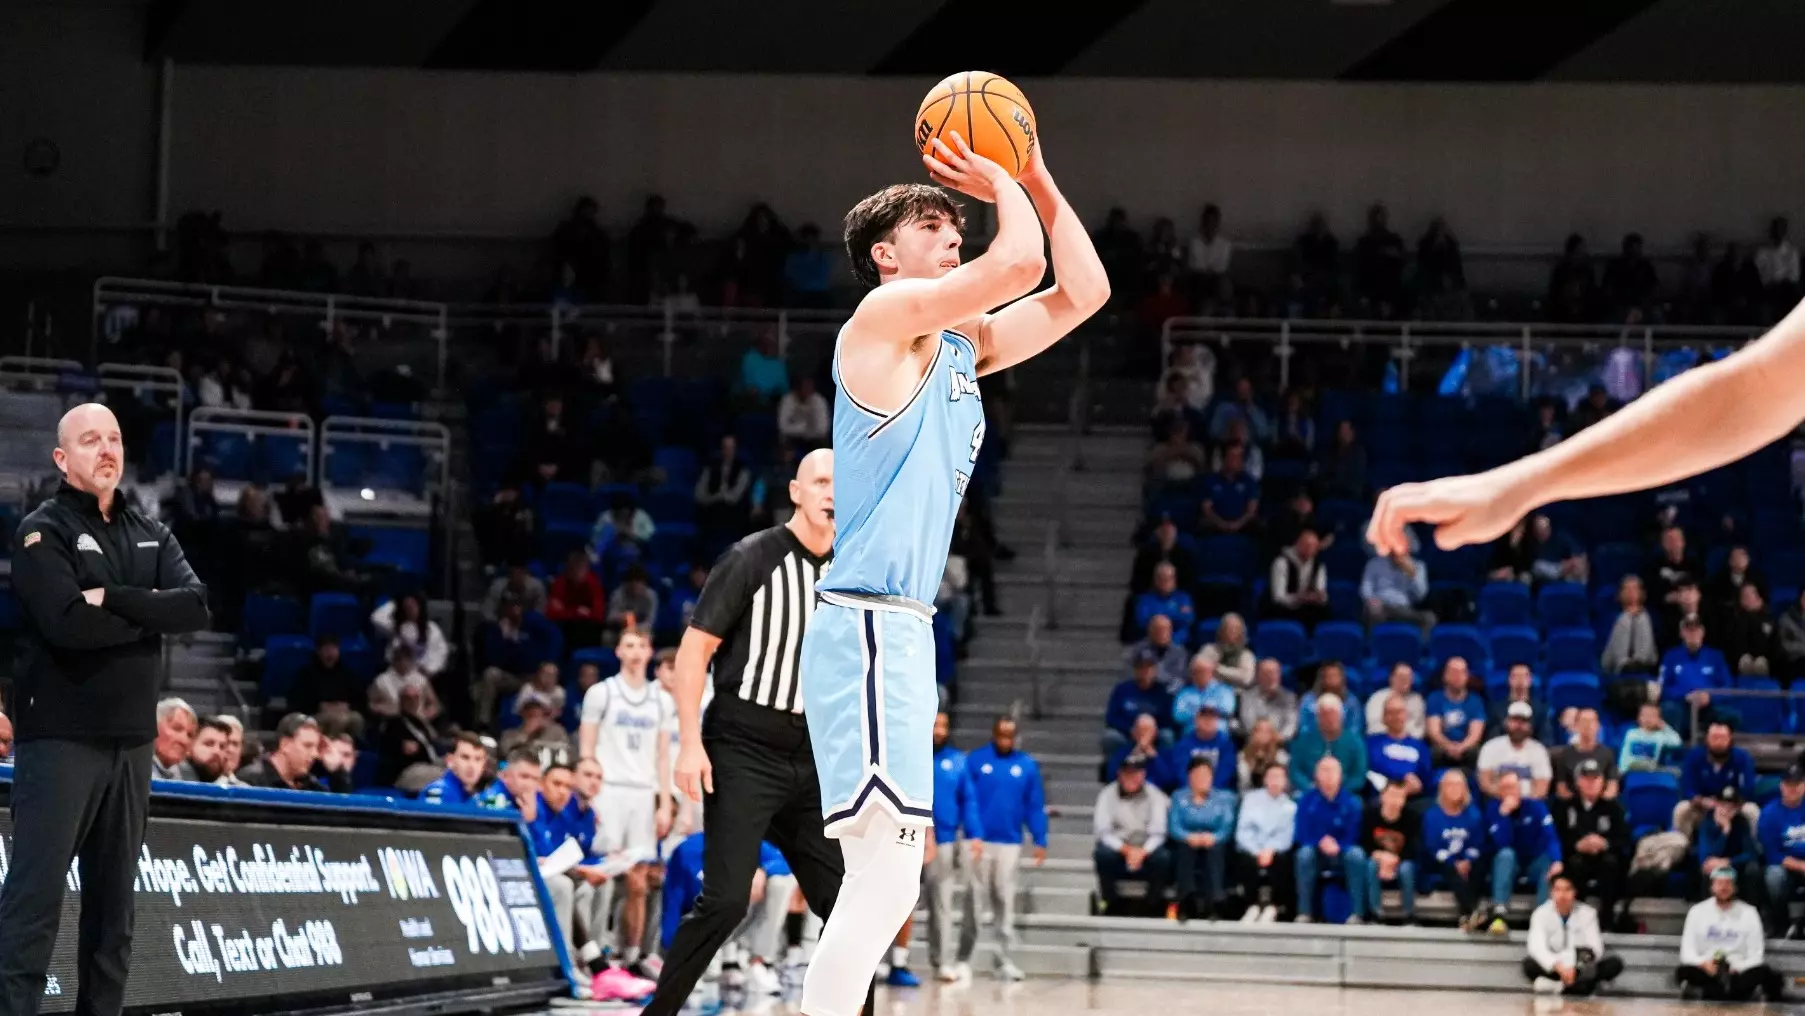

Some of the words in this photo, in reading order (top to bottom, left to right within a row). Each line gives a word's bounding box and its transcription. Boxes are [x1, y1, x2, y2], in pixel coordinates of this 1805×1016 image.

[193, 844, 233, 893] Get
[226, 843, 323, 893] Confidential
[377, 846, 440, 901] IOWA
[442, 854, 515, 955] 988
[211, 923, 259, 972] Text
[256, 937, 278, 970] or
[272, 917, 314, 968] Chat
[306, 919, 343, 965] 988
